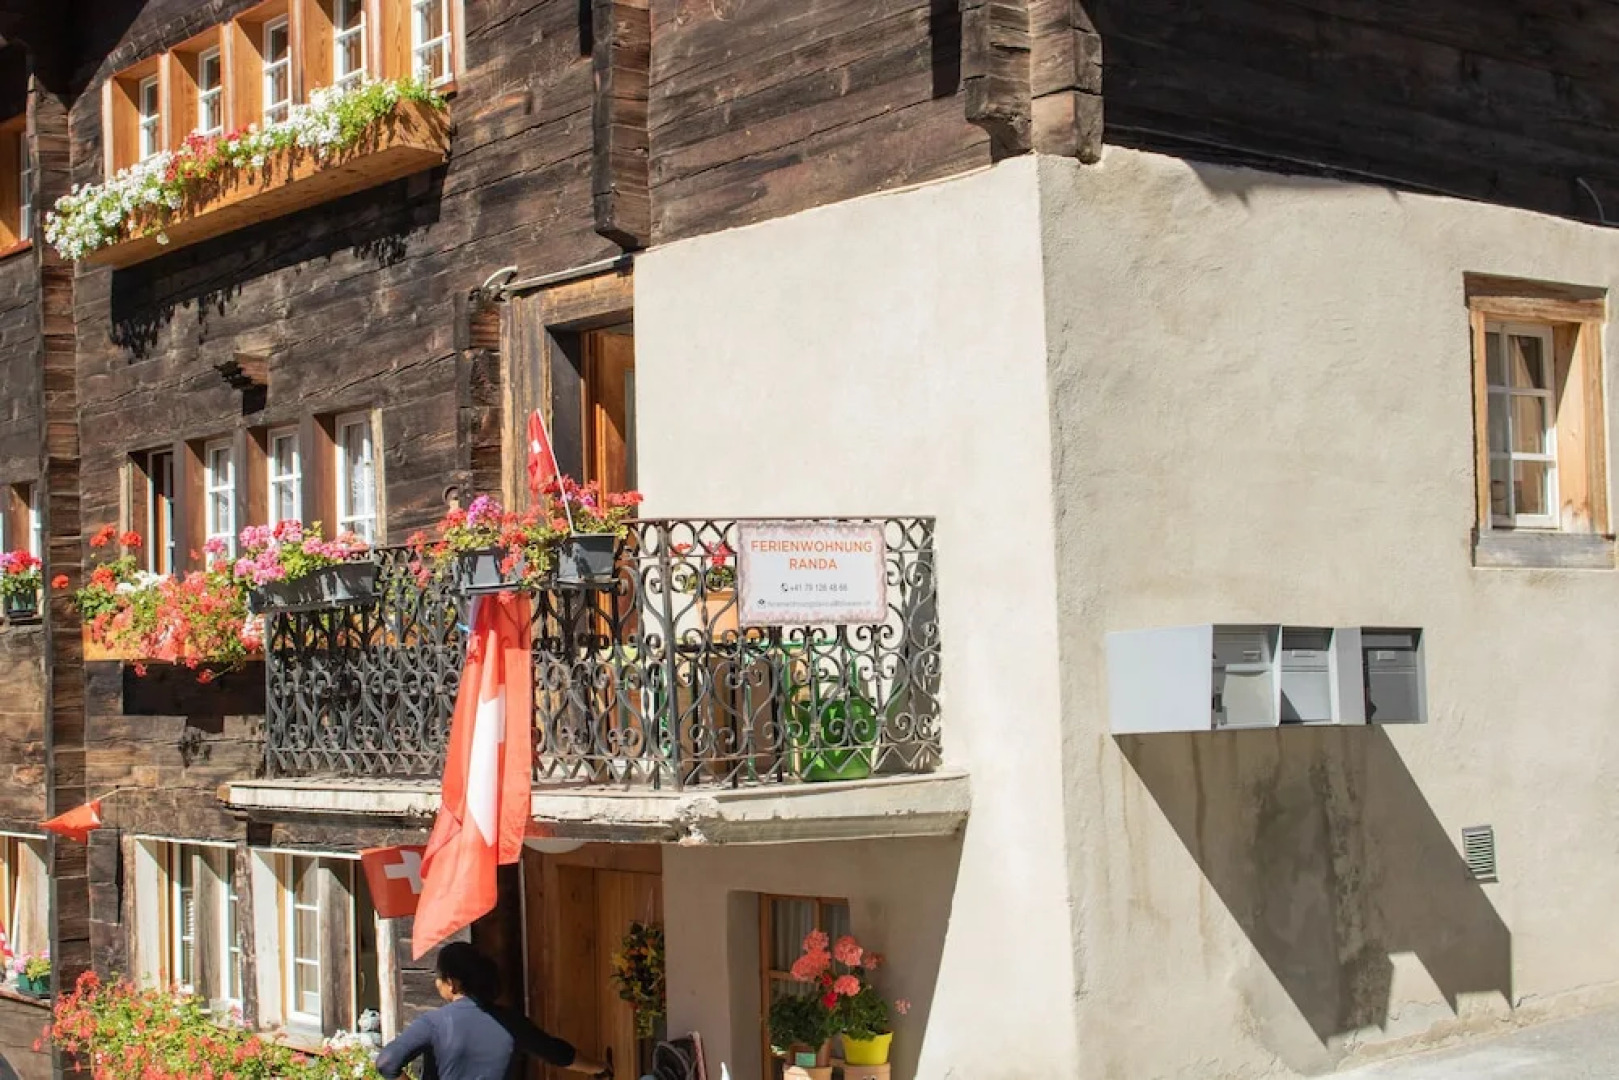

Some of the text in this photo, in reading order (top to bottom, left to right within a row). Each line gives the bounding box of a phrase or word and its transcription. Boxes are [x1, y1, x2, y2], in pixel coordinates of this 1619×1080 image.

[751, 540, 872, 552] FERIENWOHNUNG
[789, 558, 838, 570] RANDA
[790, 583, 802, 591] +41
